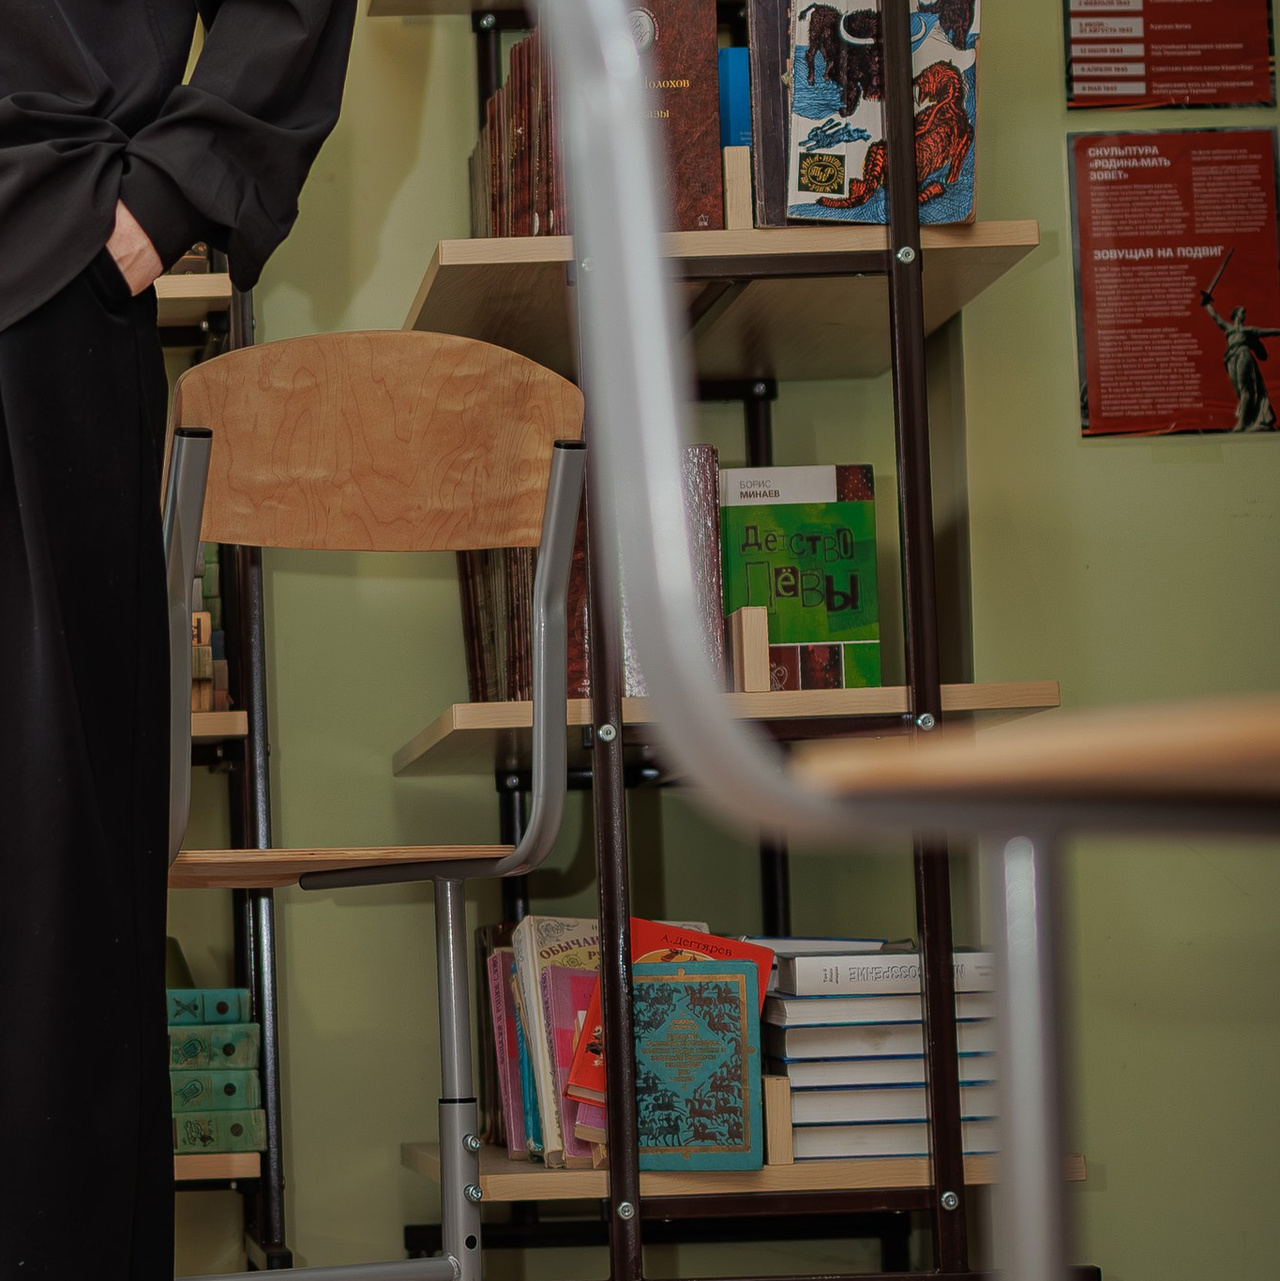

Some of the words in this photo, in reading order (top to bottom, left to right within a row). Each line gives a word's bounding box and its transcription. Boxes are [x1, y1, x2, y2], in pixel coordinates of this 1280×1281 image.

[1087, 145, 1159, 157] СКУЛЬПТУРА
[1093, 246, 1154, 261] ЗОВУЩАЯ
[1157, 246, 1174, 259] НА
[1177, 245, 1225, 260] ПОДВИГ
[739, 480, 772, 489] БОРИС
[739, 489, 781, 499] МИНАЕВ
